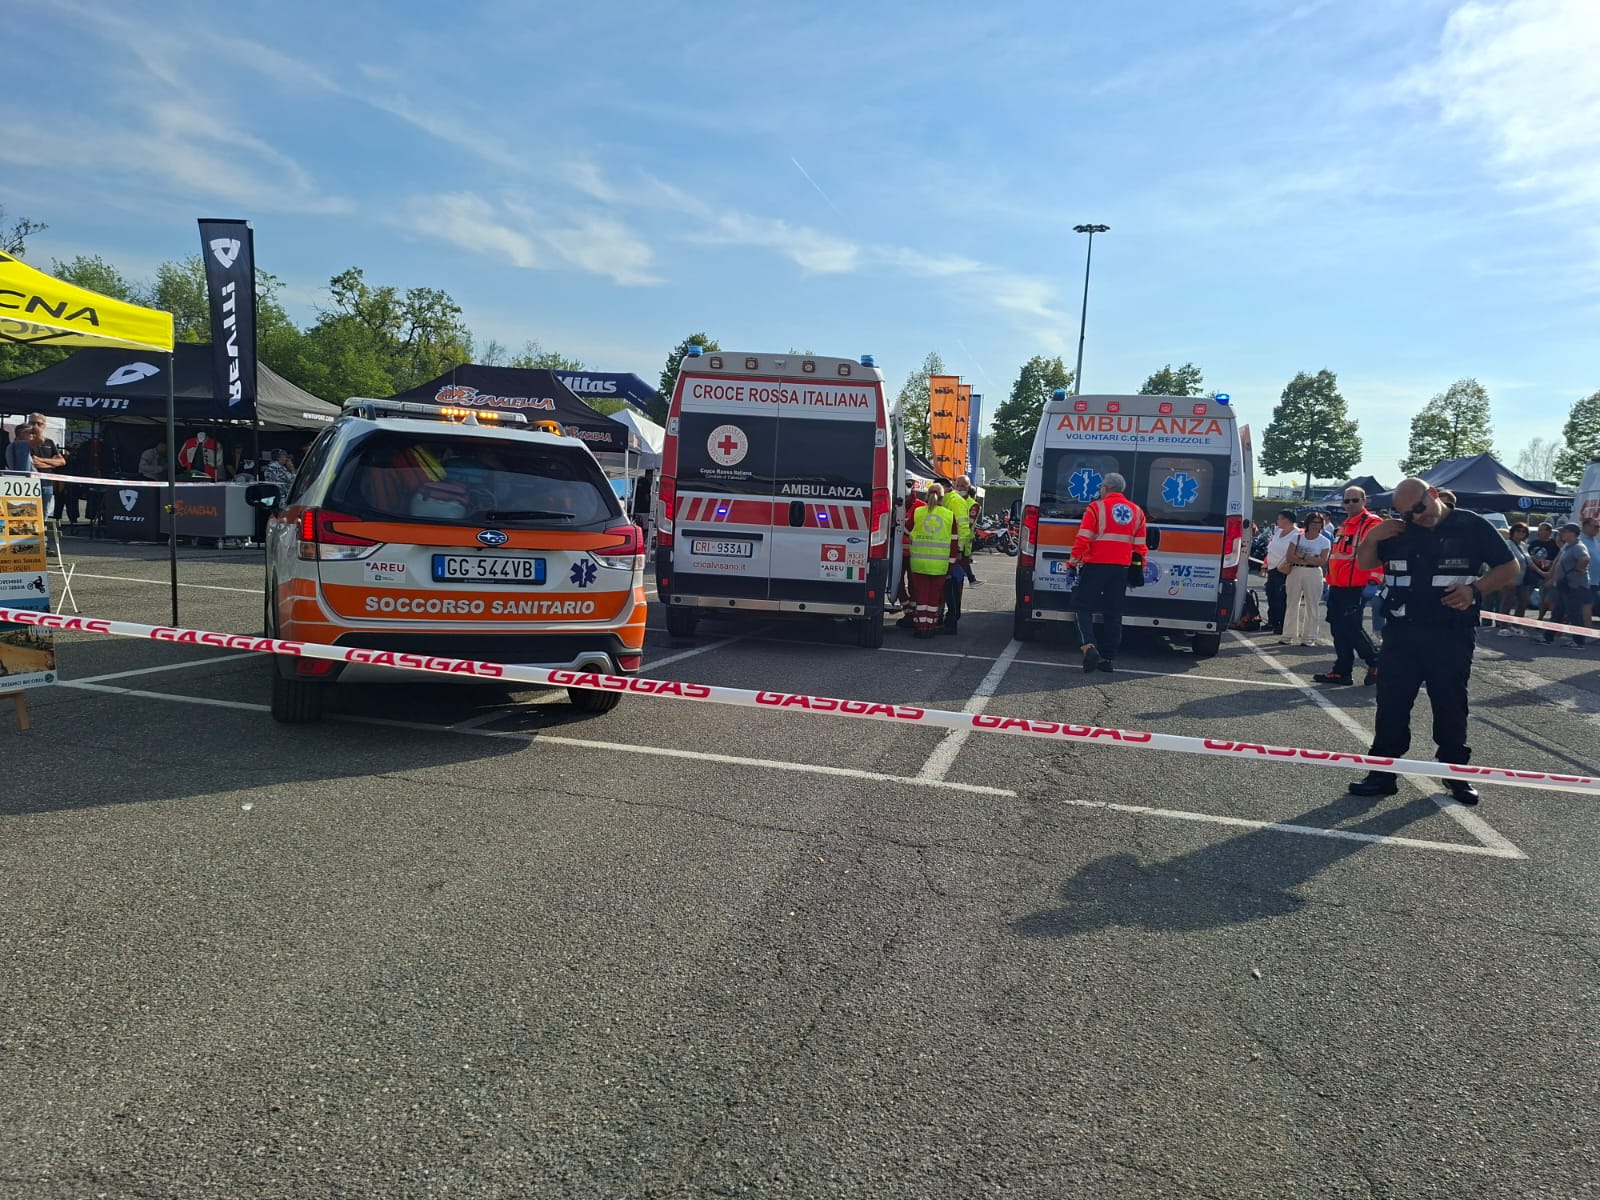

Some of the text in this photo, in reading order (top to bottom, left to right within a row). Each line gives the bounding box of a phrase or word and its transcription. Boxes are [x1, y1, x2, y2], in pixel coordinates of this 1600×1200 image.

[57, 396, 130, 409] REV'IT!
[692, 384, 869, 408] CROCE ROSSA ITALIANA
[1057, 415, 1223, 436] AMBULANZA
[1066, 433, 1119, 441] VOLONTARI
[1158, 437, 1211, 445] BEDIZZOLE
[4, 481, 41, 497] 2026
[781, 484, 863, 498] AMBULANZA
[696, 542, 710, 552] CRI
[370, 562, 405, 573] AREU
[447, 558, 533, 579] GG 544VB
[365, 597, 595, 615] SOCCORSO SANITARIO
[344, 648, 503, 677] GASGAS
[547, 669, 711, 698] GASGAS
